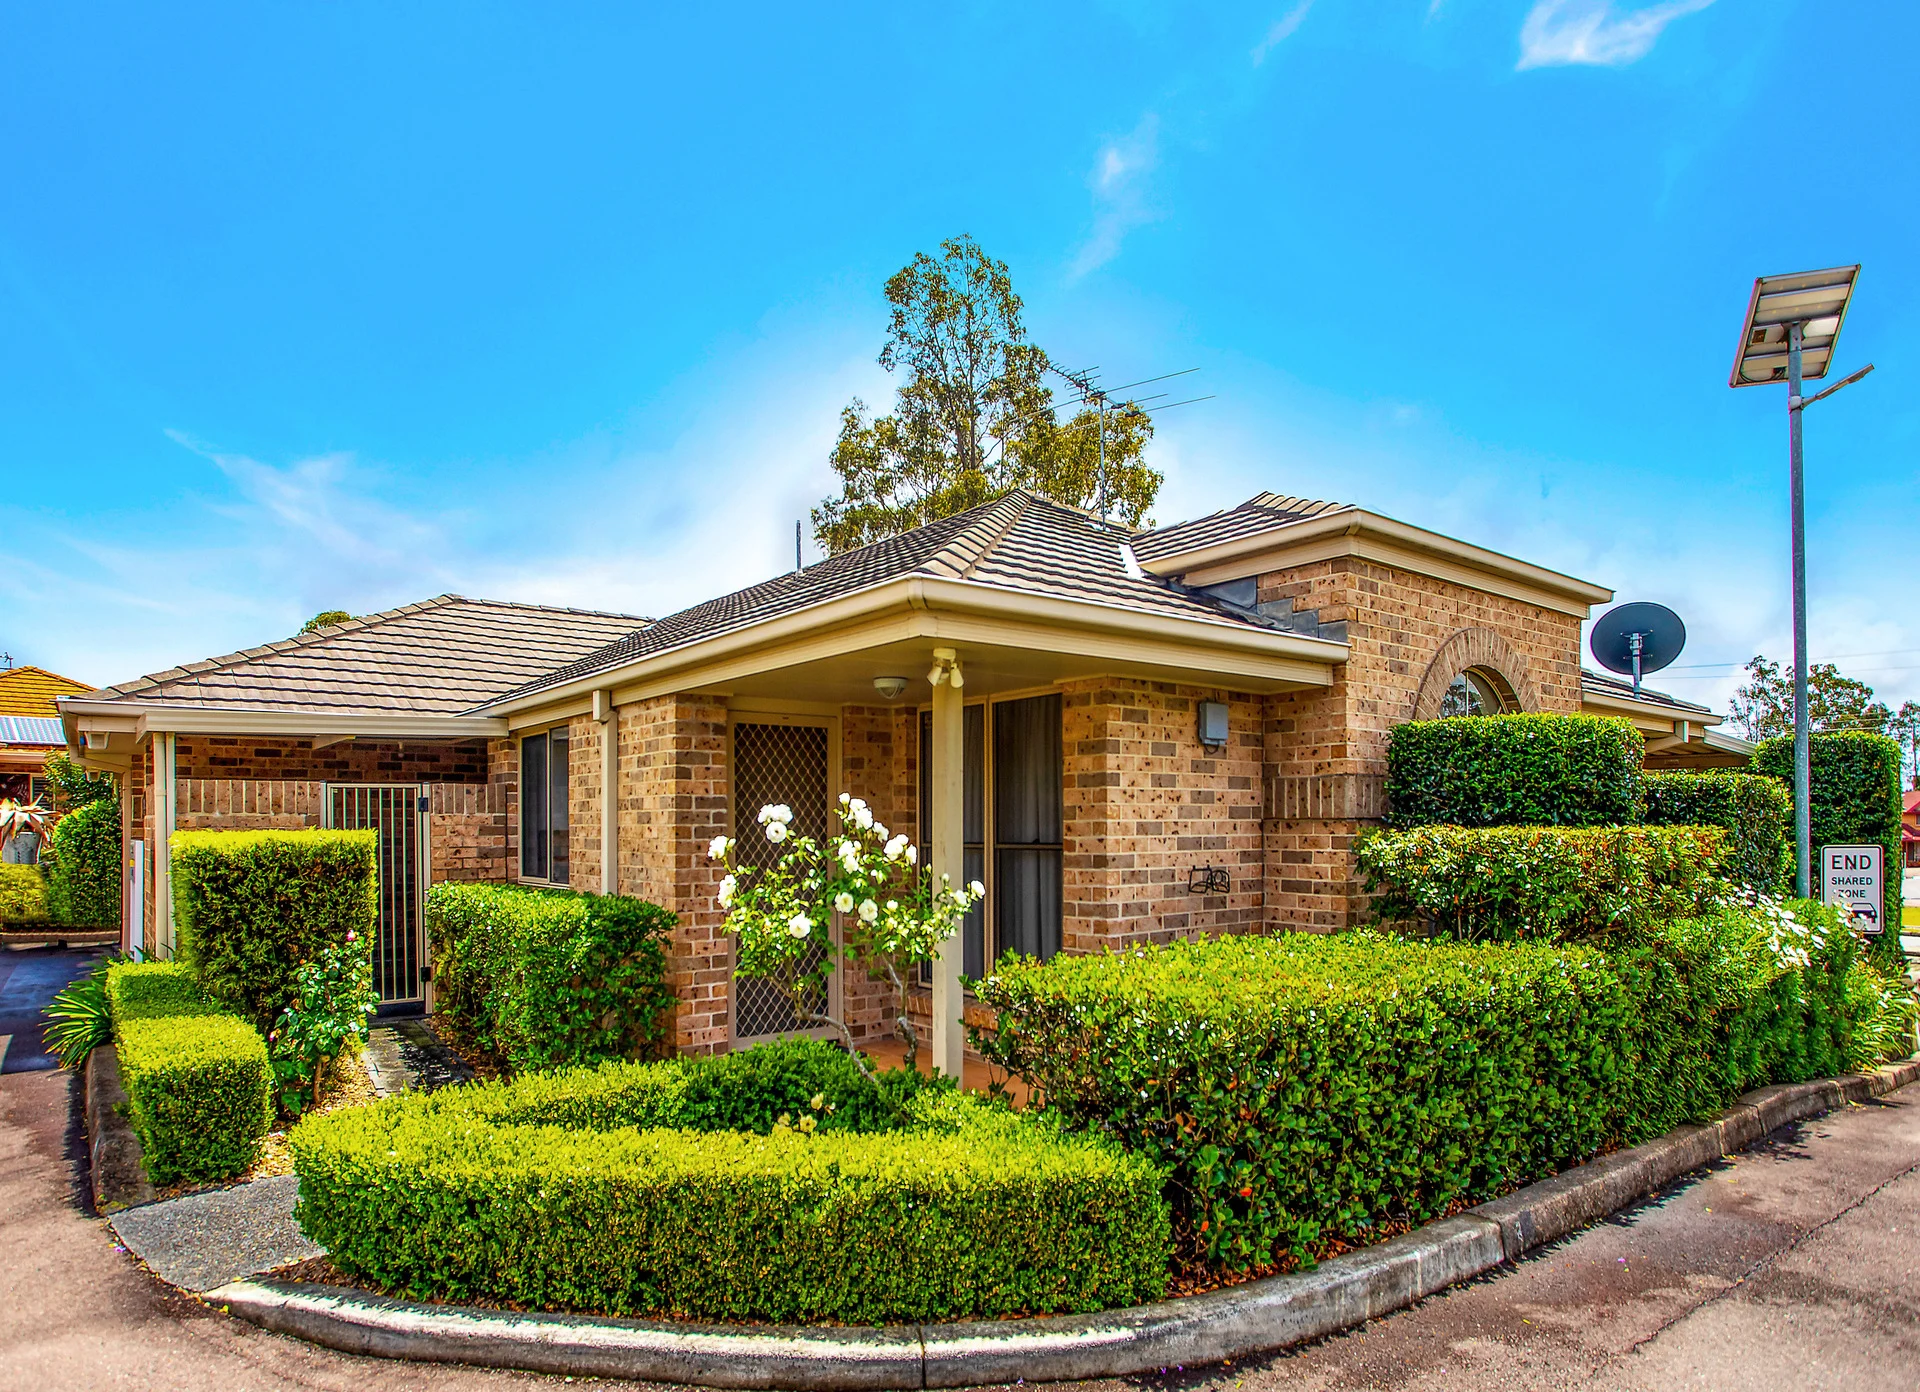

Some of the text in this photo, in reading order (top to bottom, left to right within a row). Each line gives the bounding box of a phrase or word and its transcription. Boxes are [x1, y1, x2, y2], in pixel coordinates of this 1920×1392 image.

[1831, 854, 1872, 870] END
[1831, 876, 1873, 885] SHARED
[1837, 889, 1866, 898] ZONE
